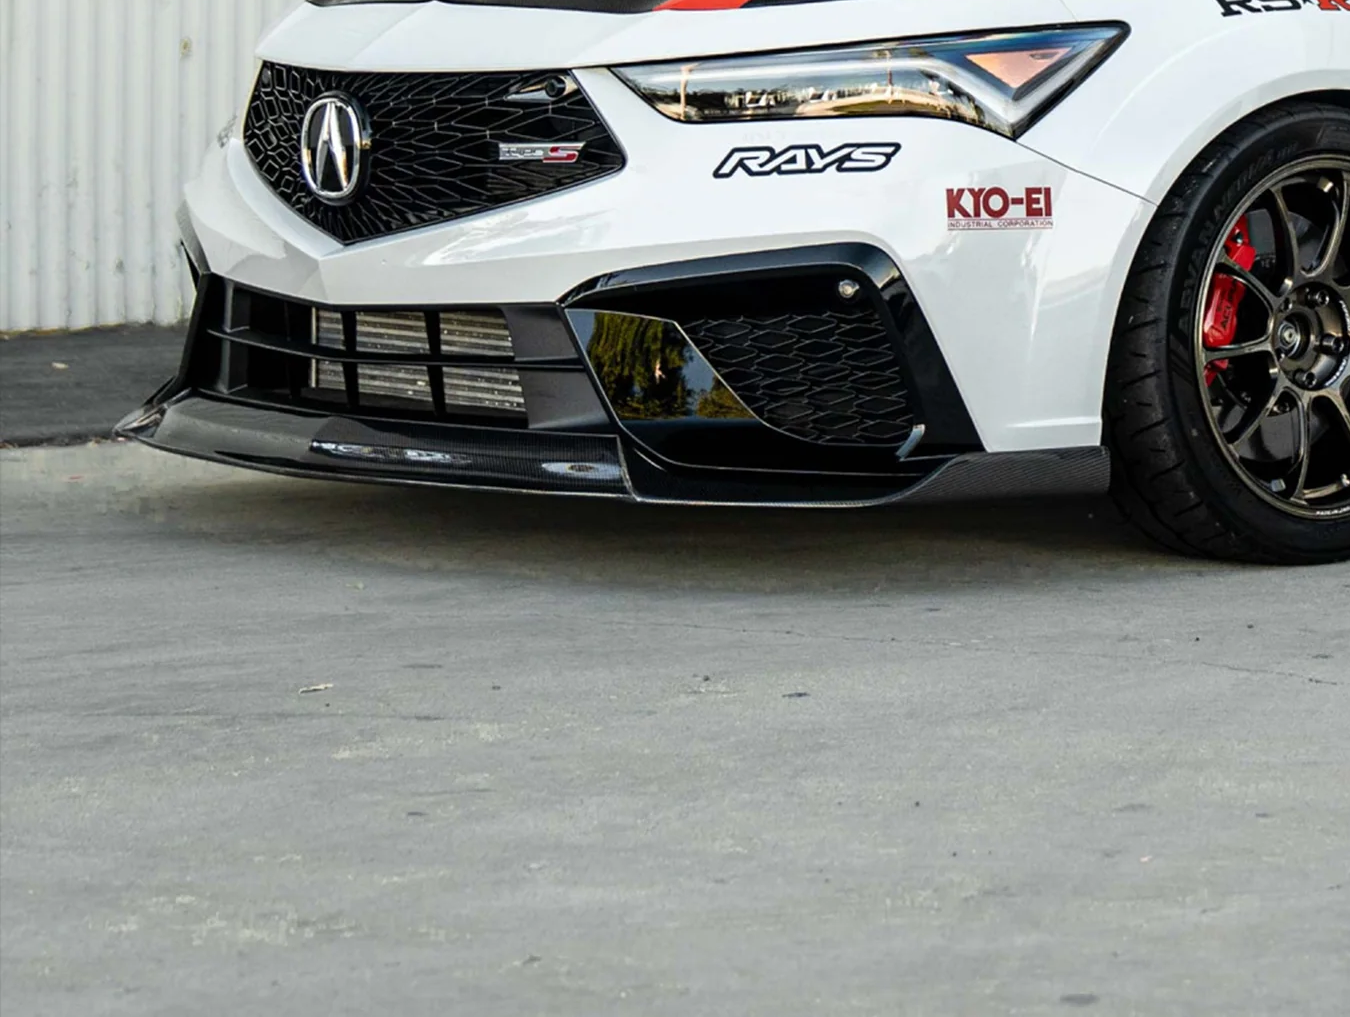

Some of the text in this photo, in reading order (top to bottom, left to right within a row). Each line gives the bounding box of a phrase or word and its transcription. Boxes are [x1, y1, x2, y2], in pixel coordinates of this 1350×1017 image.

[712, 142, 902, 179] RAYS
[945, 186, 1053, 219] KYO-EI
[947, 220, 993, 228] INDUSTRIAL
